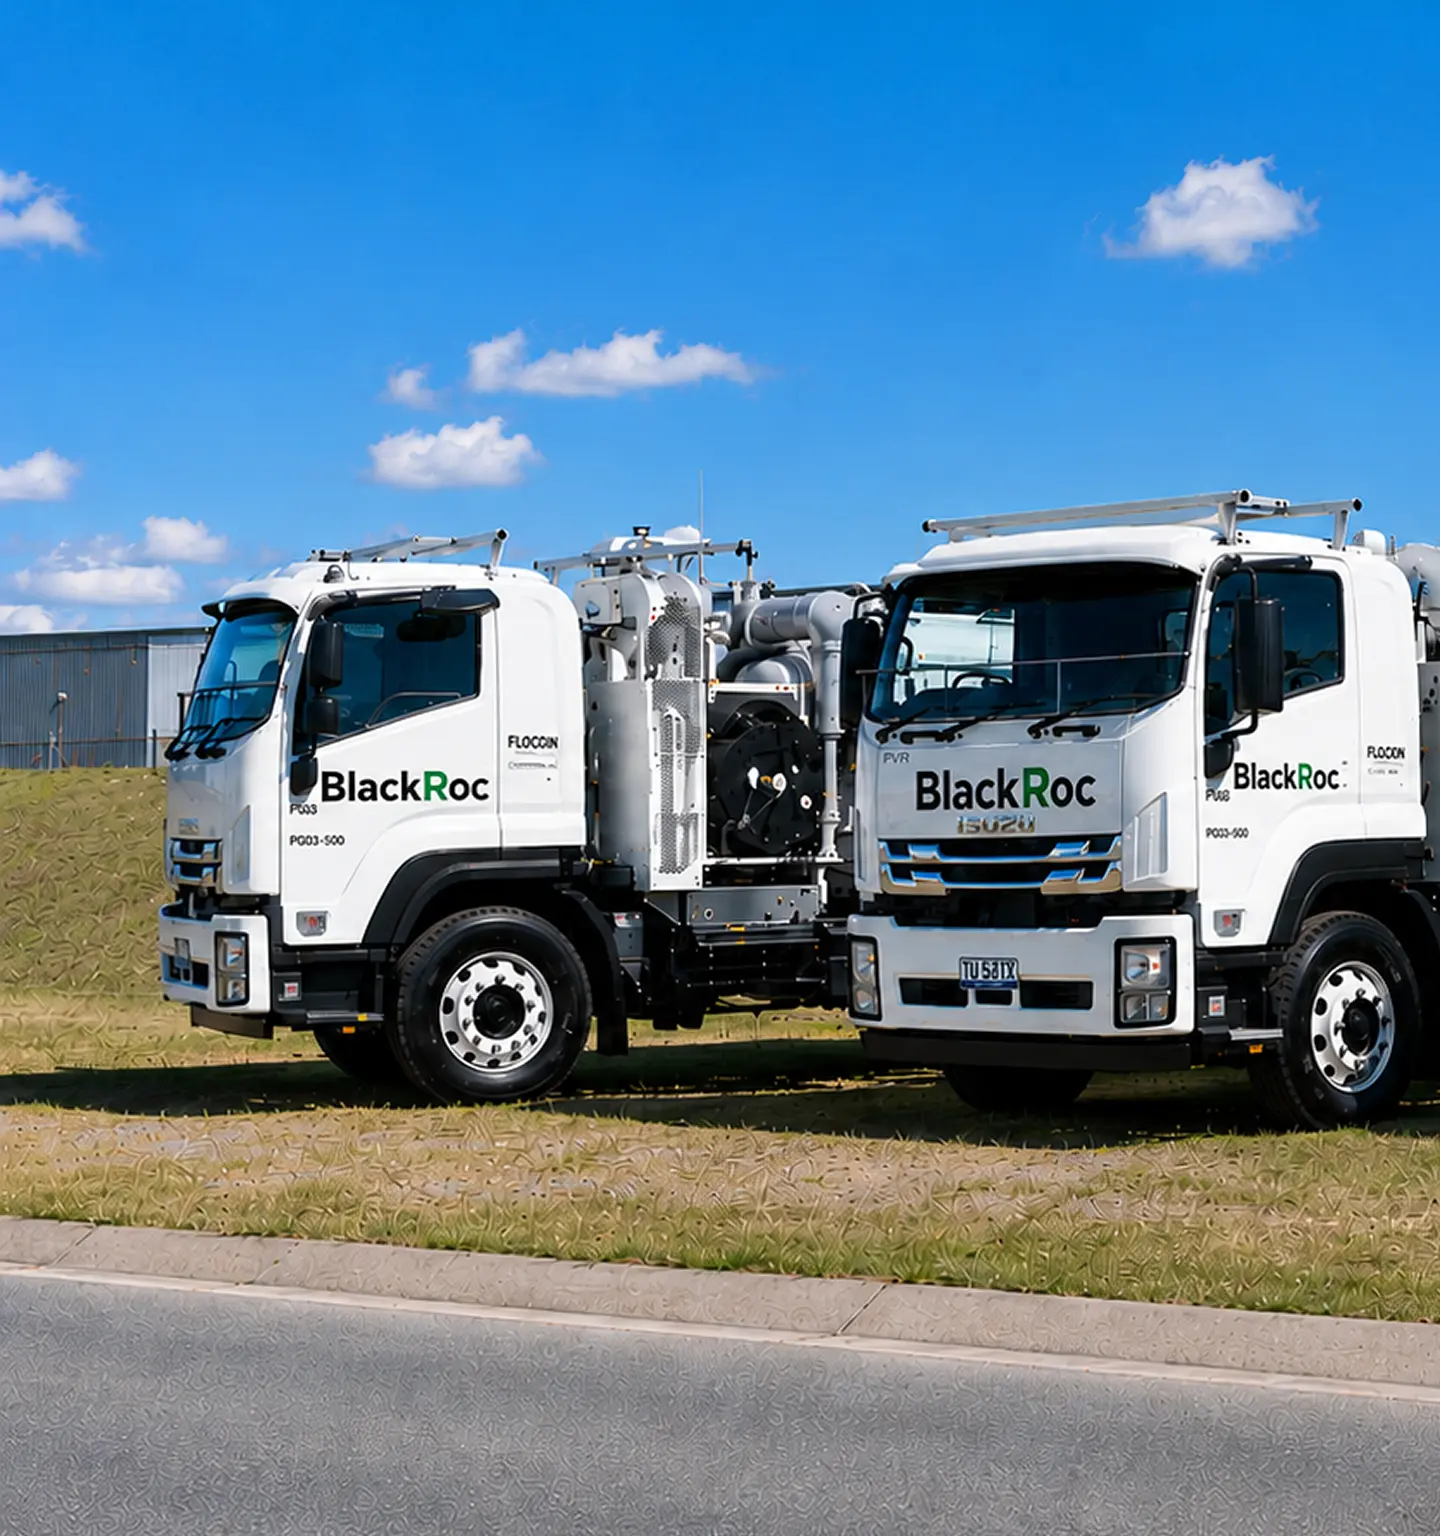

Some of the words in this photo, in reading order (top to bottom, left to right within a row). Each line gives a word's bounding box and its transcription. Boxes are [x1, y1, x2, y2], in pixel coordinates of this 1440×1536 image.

[883, 752, 911, 764] PVR
[321, 770, 490, 802] BlackRoc
[916, 766, 1096, 811] BlackRoc
[1233, 762, 1340, 790] BlackRoc
[957, 814, 1036, 834] ISUZU
